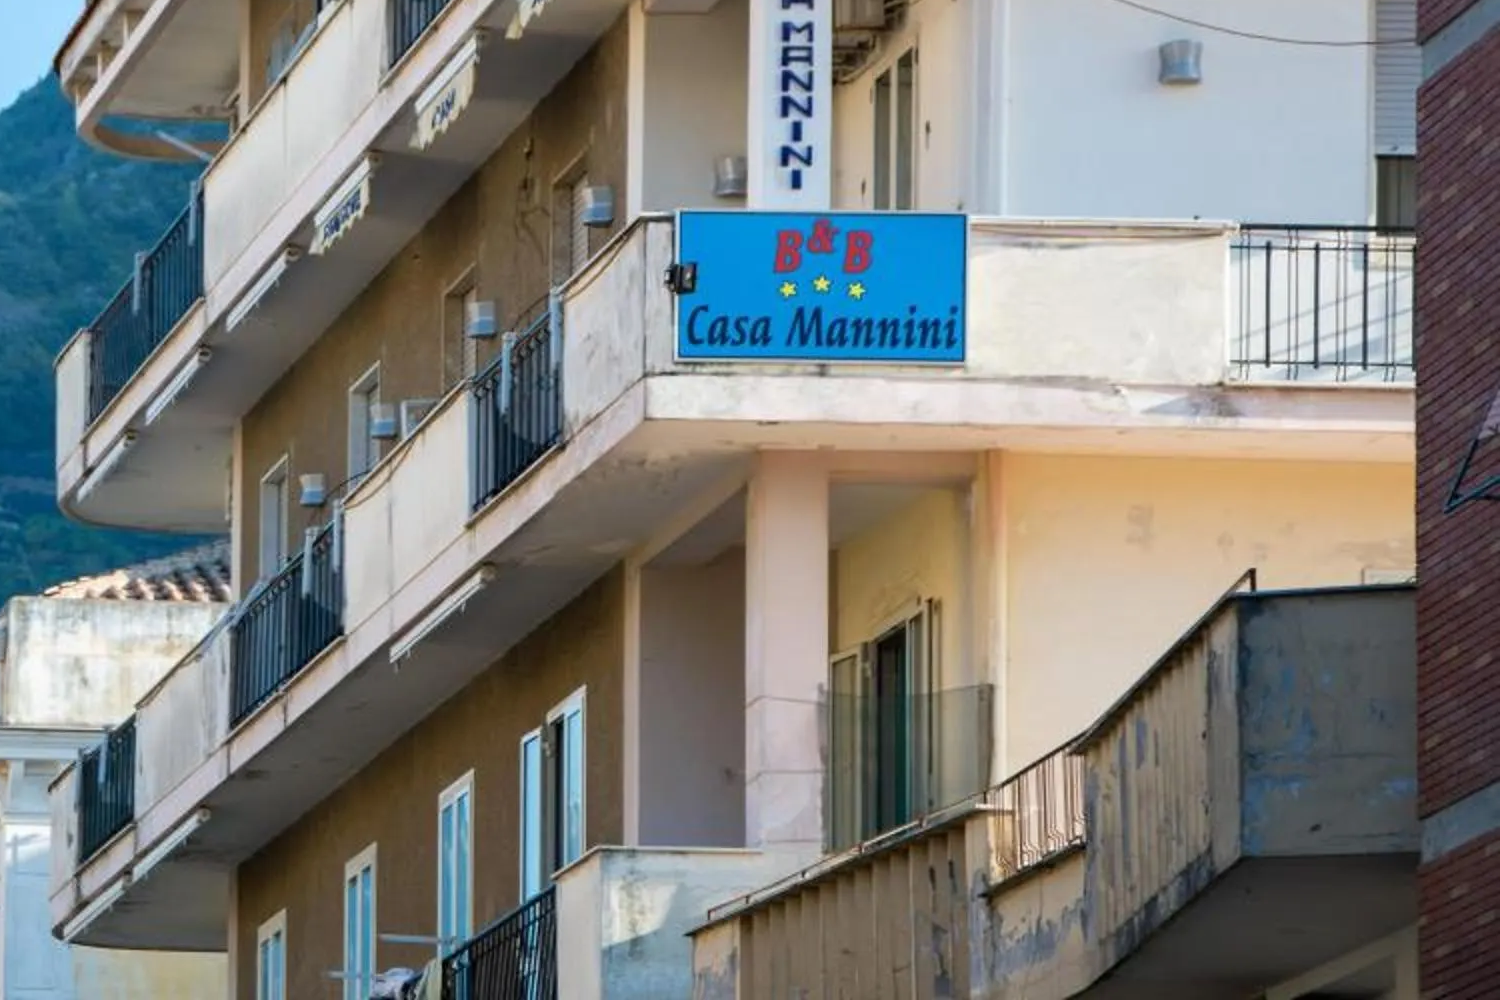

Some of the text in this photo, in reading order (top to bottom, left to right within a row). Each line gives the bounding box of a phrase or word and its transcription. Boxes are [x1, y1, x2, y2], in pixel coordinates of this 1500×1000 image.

[779, 21, 815, 190] MANNINI
[773, 217, 874, 274] B&B
[686, 304, 960, 350] Casa Mannini
